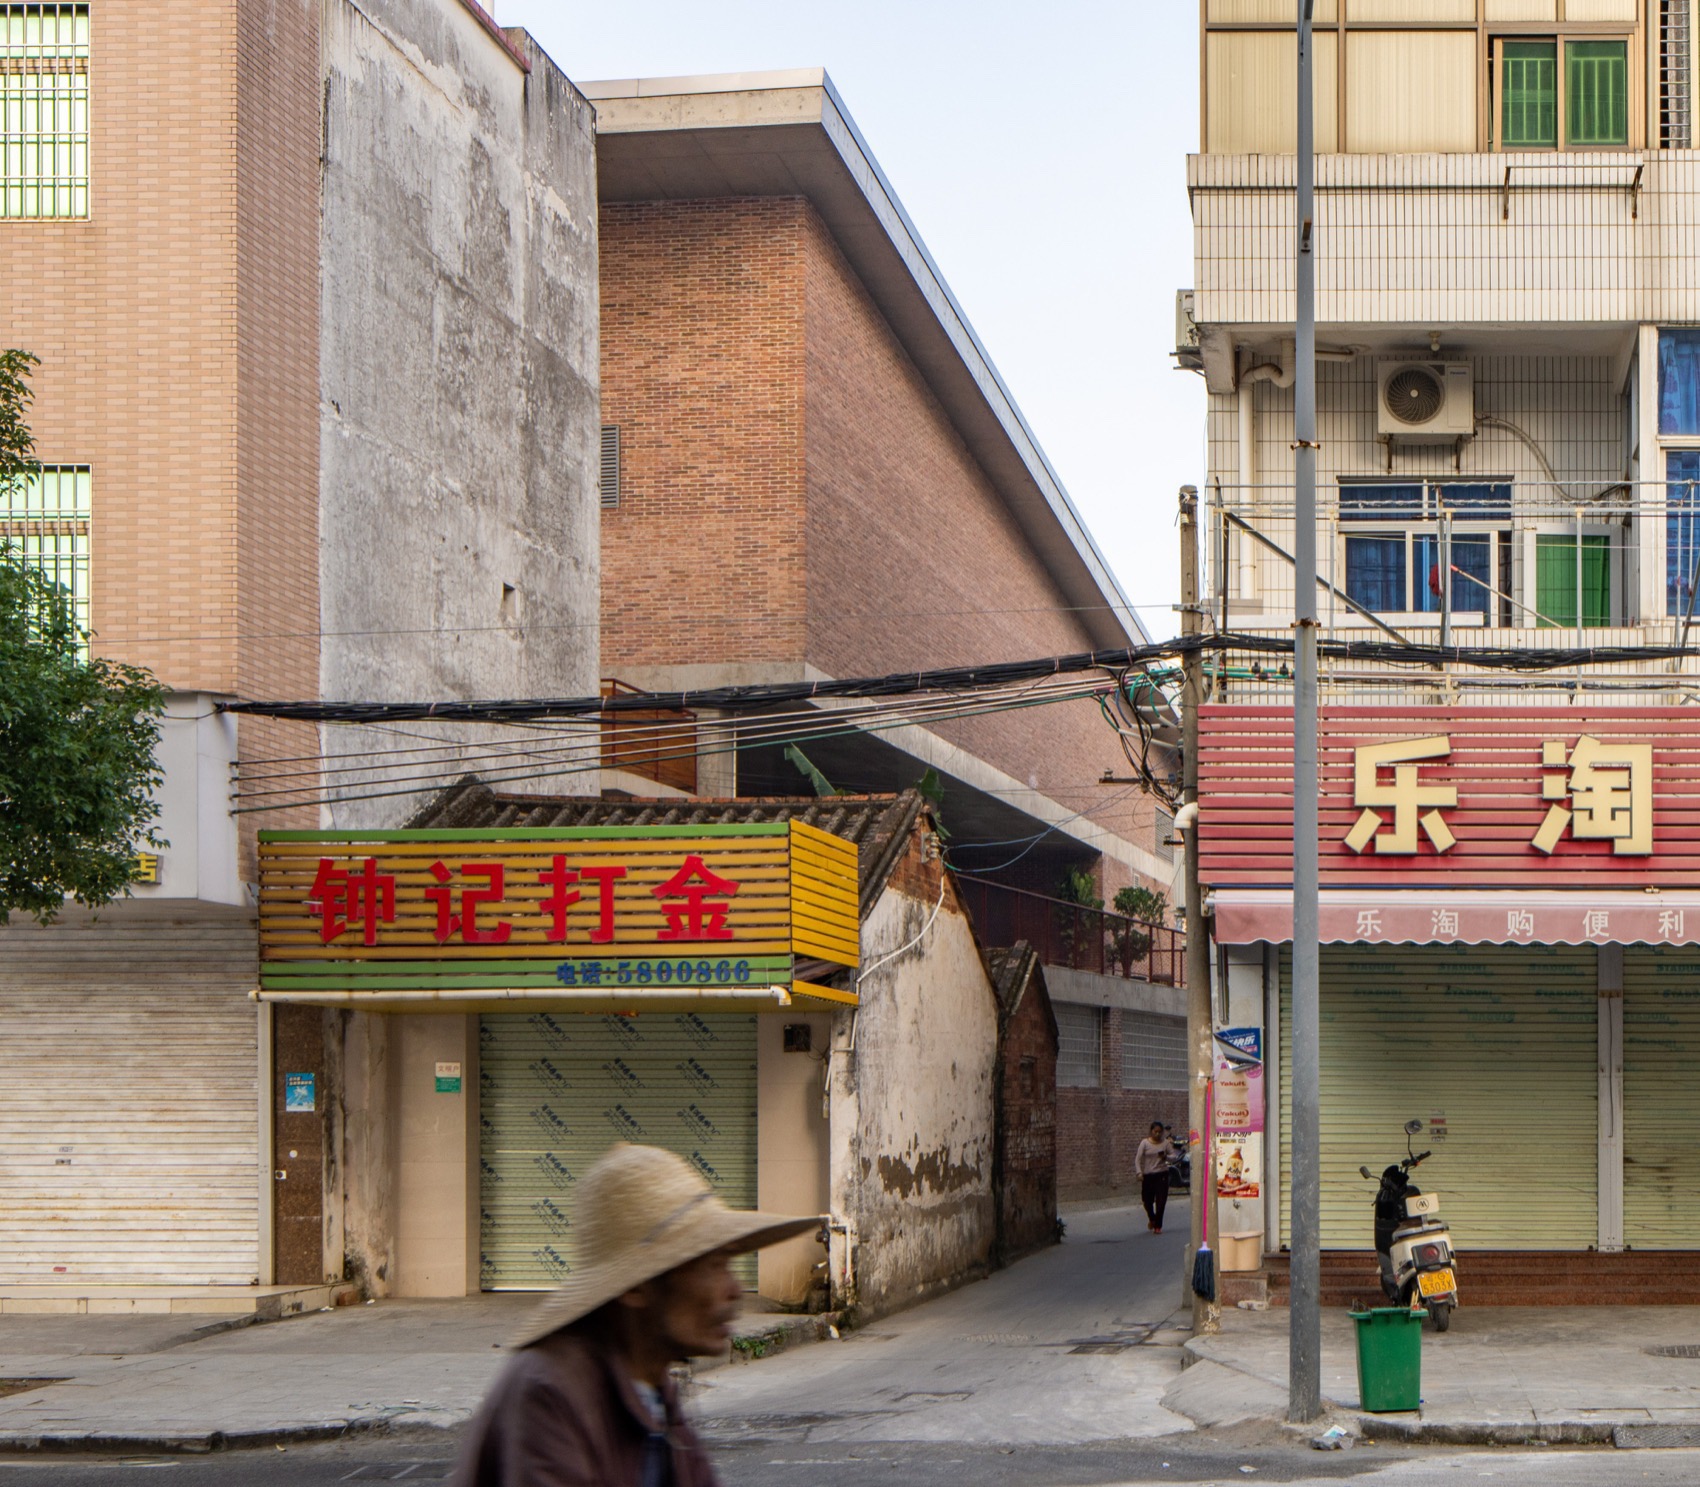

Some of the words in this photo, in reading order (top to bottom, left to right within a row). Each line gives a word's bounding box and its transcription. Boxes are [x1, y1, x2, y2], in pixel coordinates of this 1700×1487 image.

[1343, 733, 1654, 855] 乐淘
[308, 855, 740, 946] 钟记打金
[1355, 908, 1685, 938] 乐淘购便利
